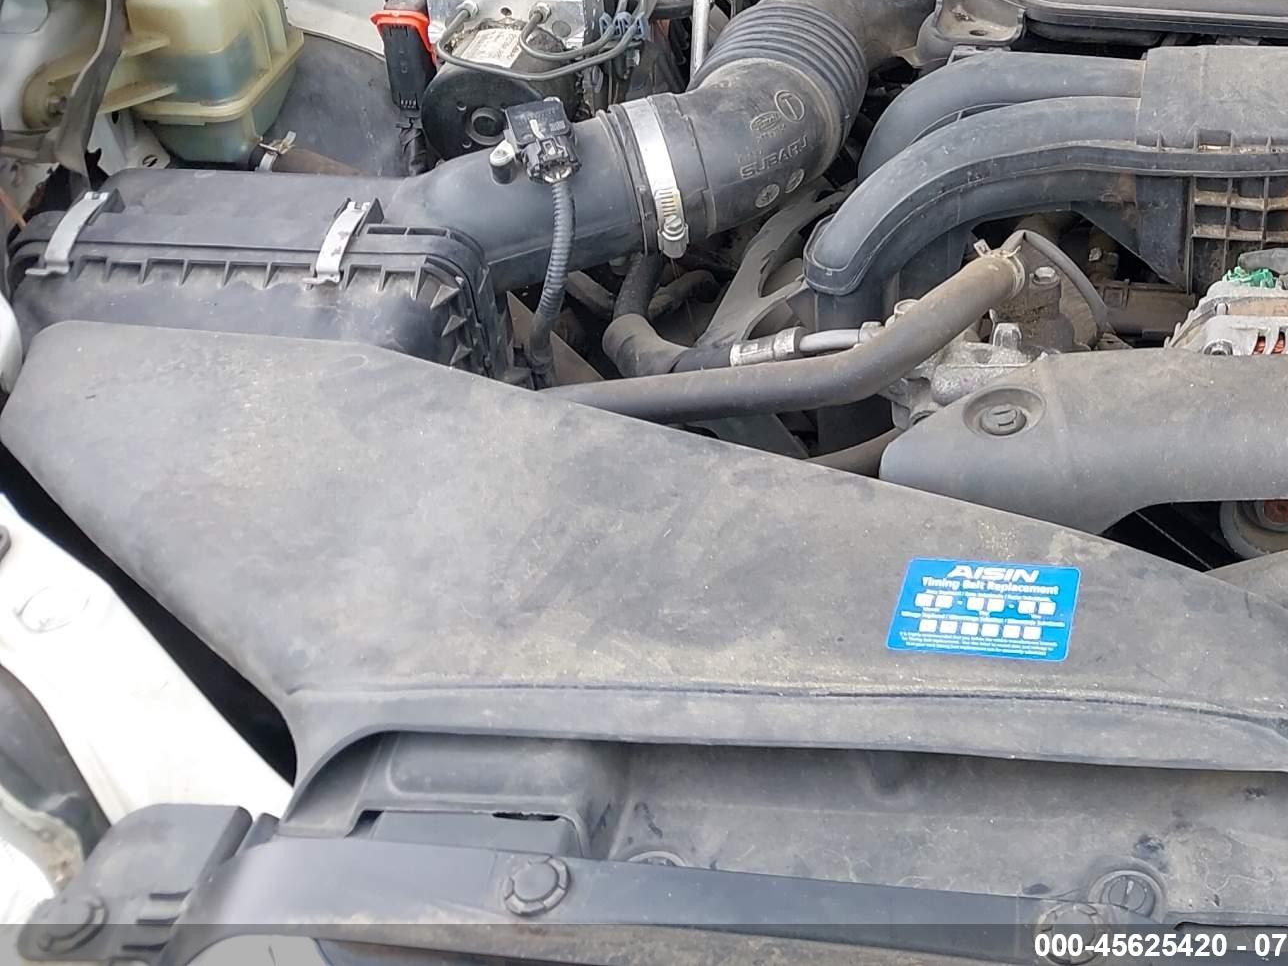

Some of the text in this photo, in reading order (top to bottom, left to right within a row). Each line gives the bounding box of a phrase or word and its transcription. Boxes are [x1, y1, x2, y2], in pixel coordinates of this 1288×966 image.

[740, 134, 807, 180] SUBARU
[946, 565, 1040, 583] AISIN
[922, 576, 960, 590] Timing
[963, 579, 984, 590] Belt
[986, 581, 1060, 596] Replacement
